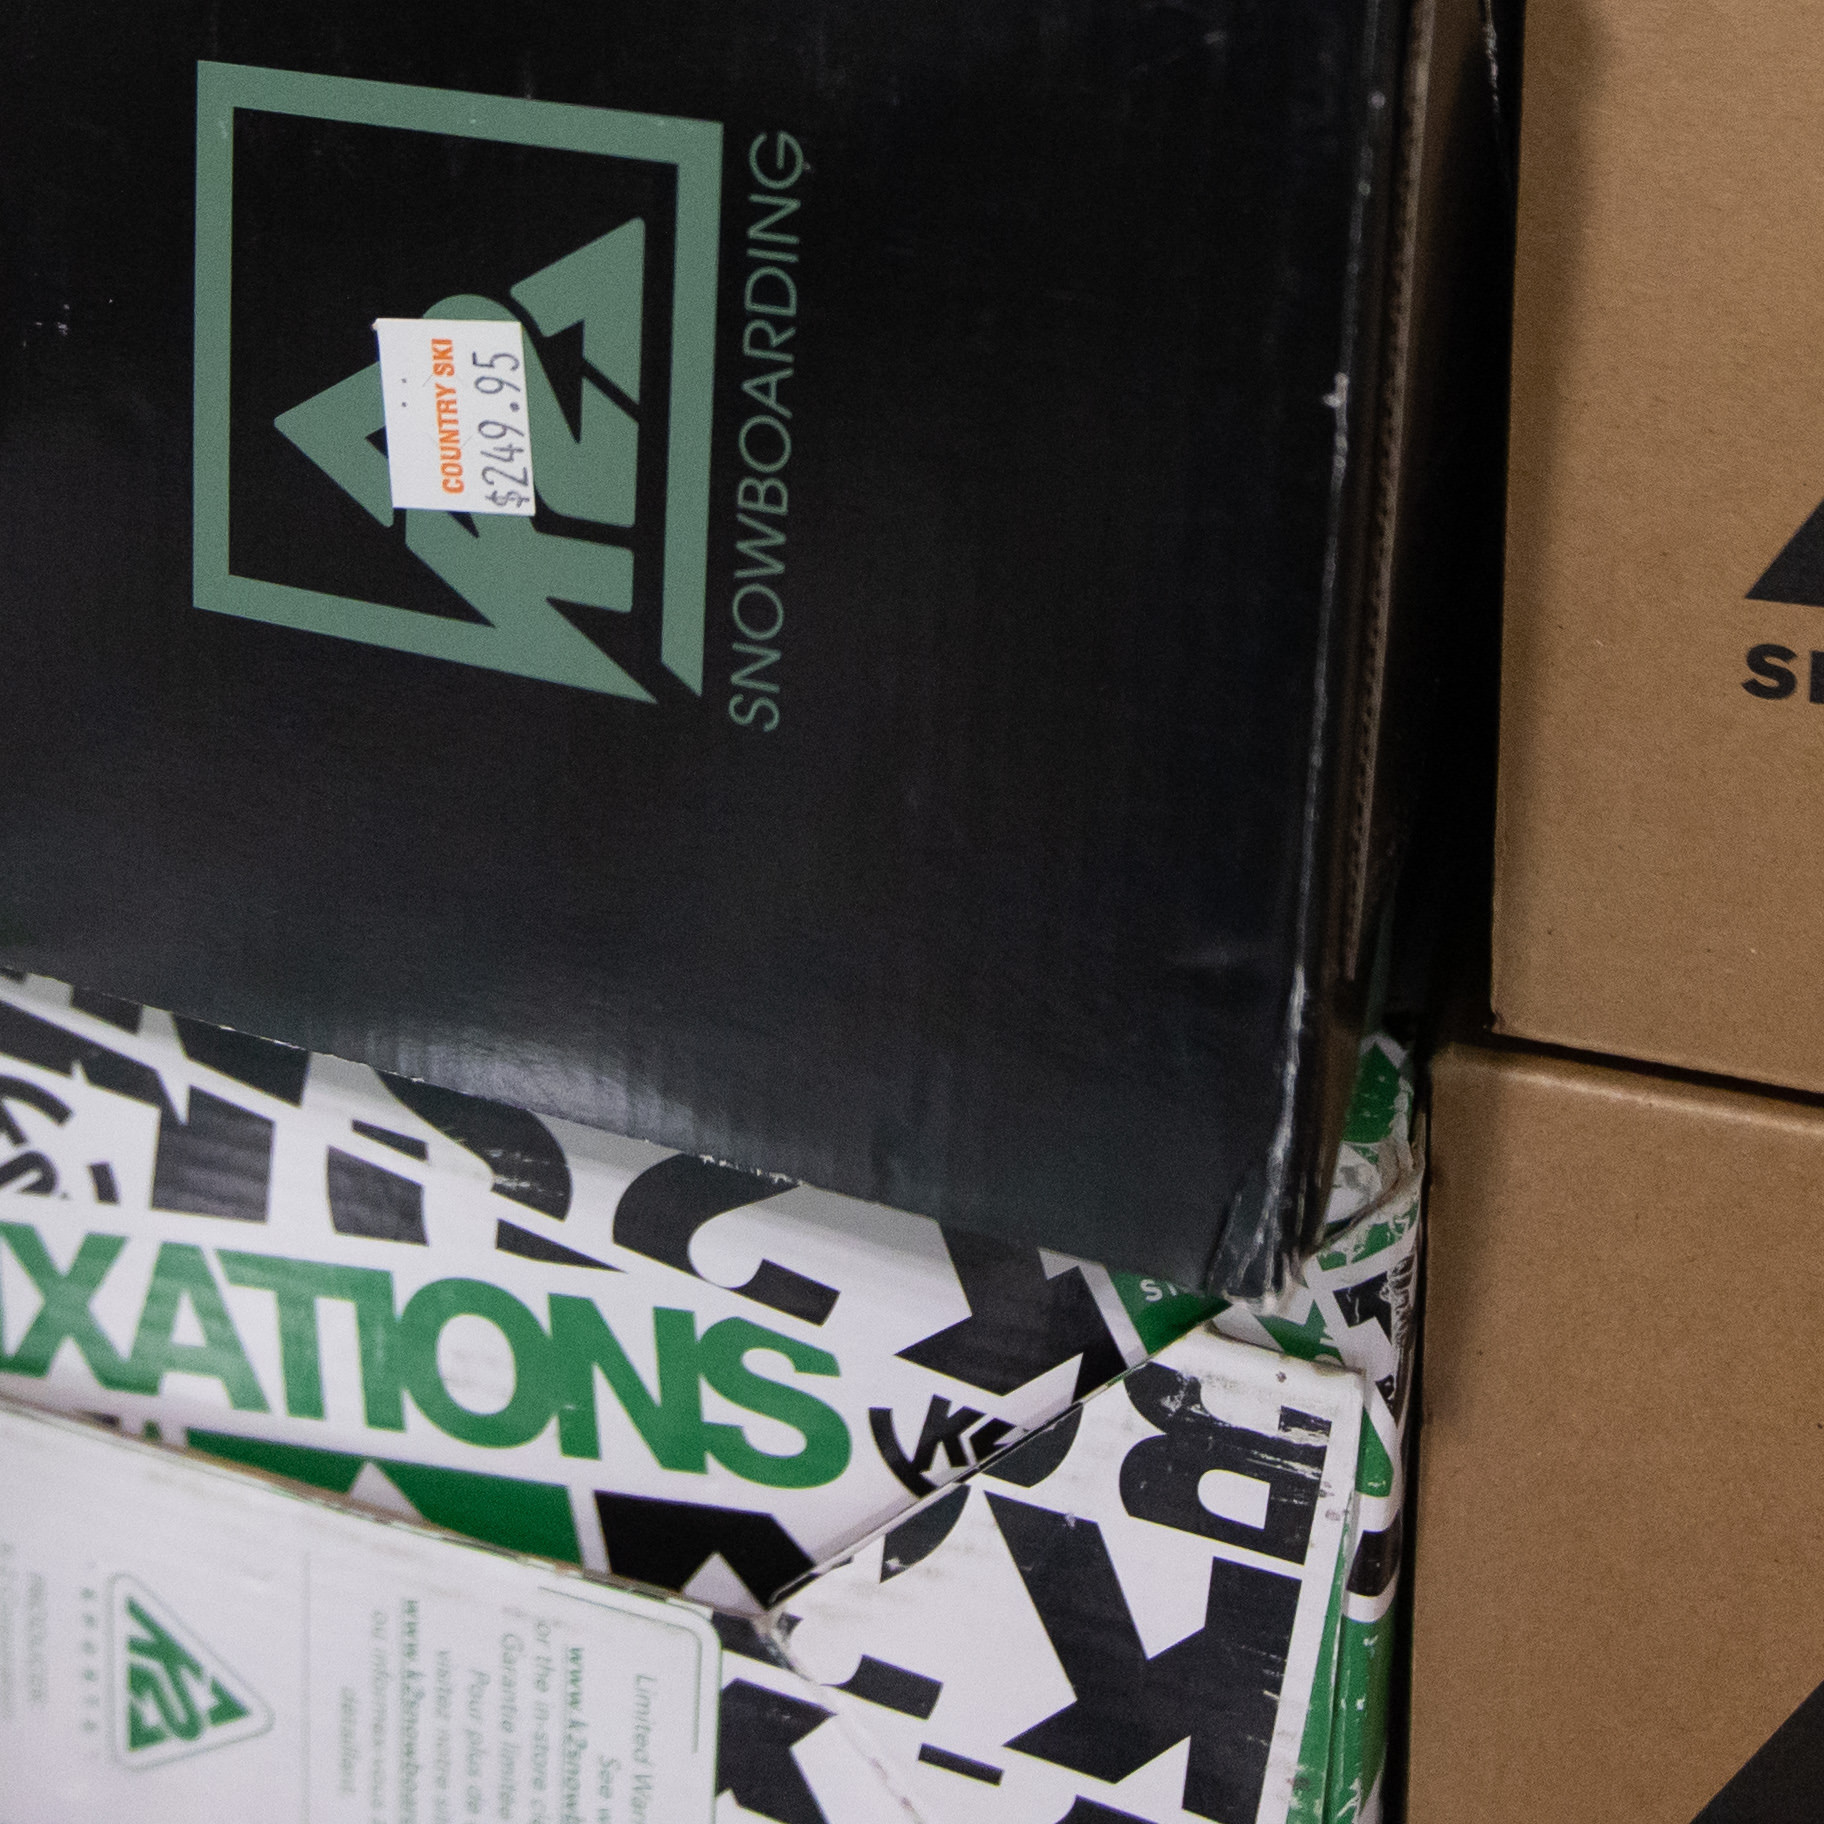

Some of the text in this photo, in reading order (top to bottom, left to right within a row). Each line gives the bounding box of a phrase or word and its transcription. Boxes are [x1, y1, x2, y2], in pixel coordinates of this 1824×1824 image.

[430, 337, 467, 496] COUNTRY SKI
[471, 349, 532, 509] $249.95
[728, 129, 807, 733] SNOWBOARDING
